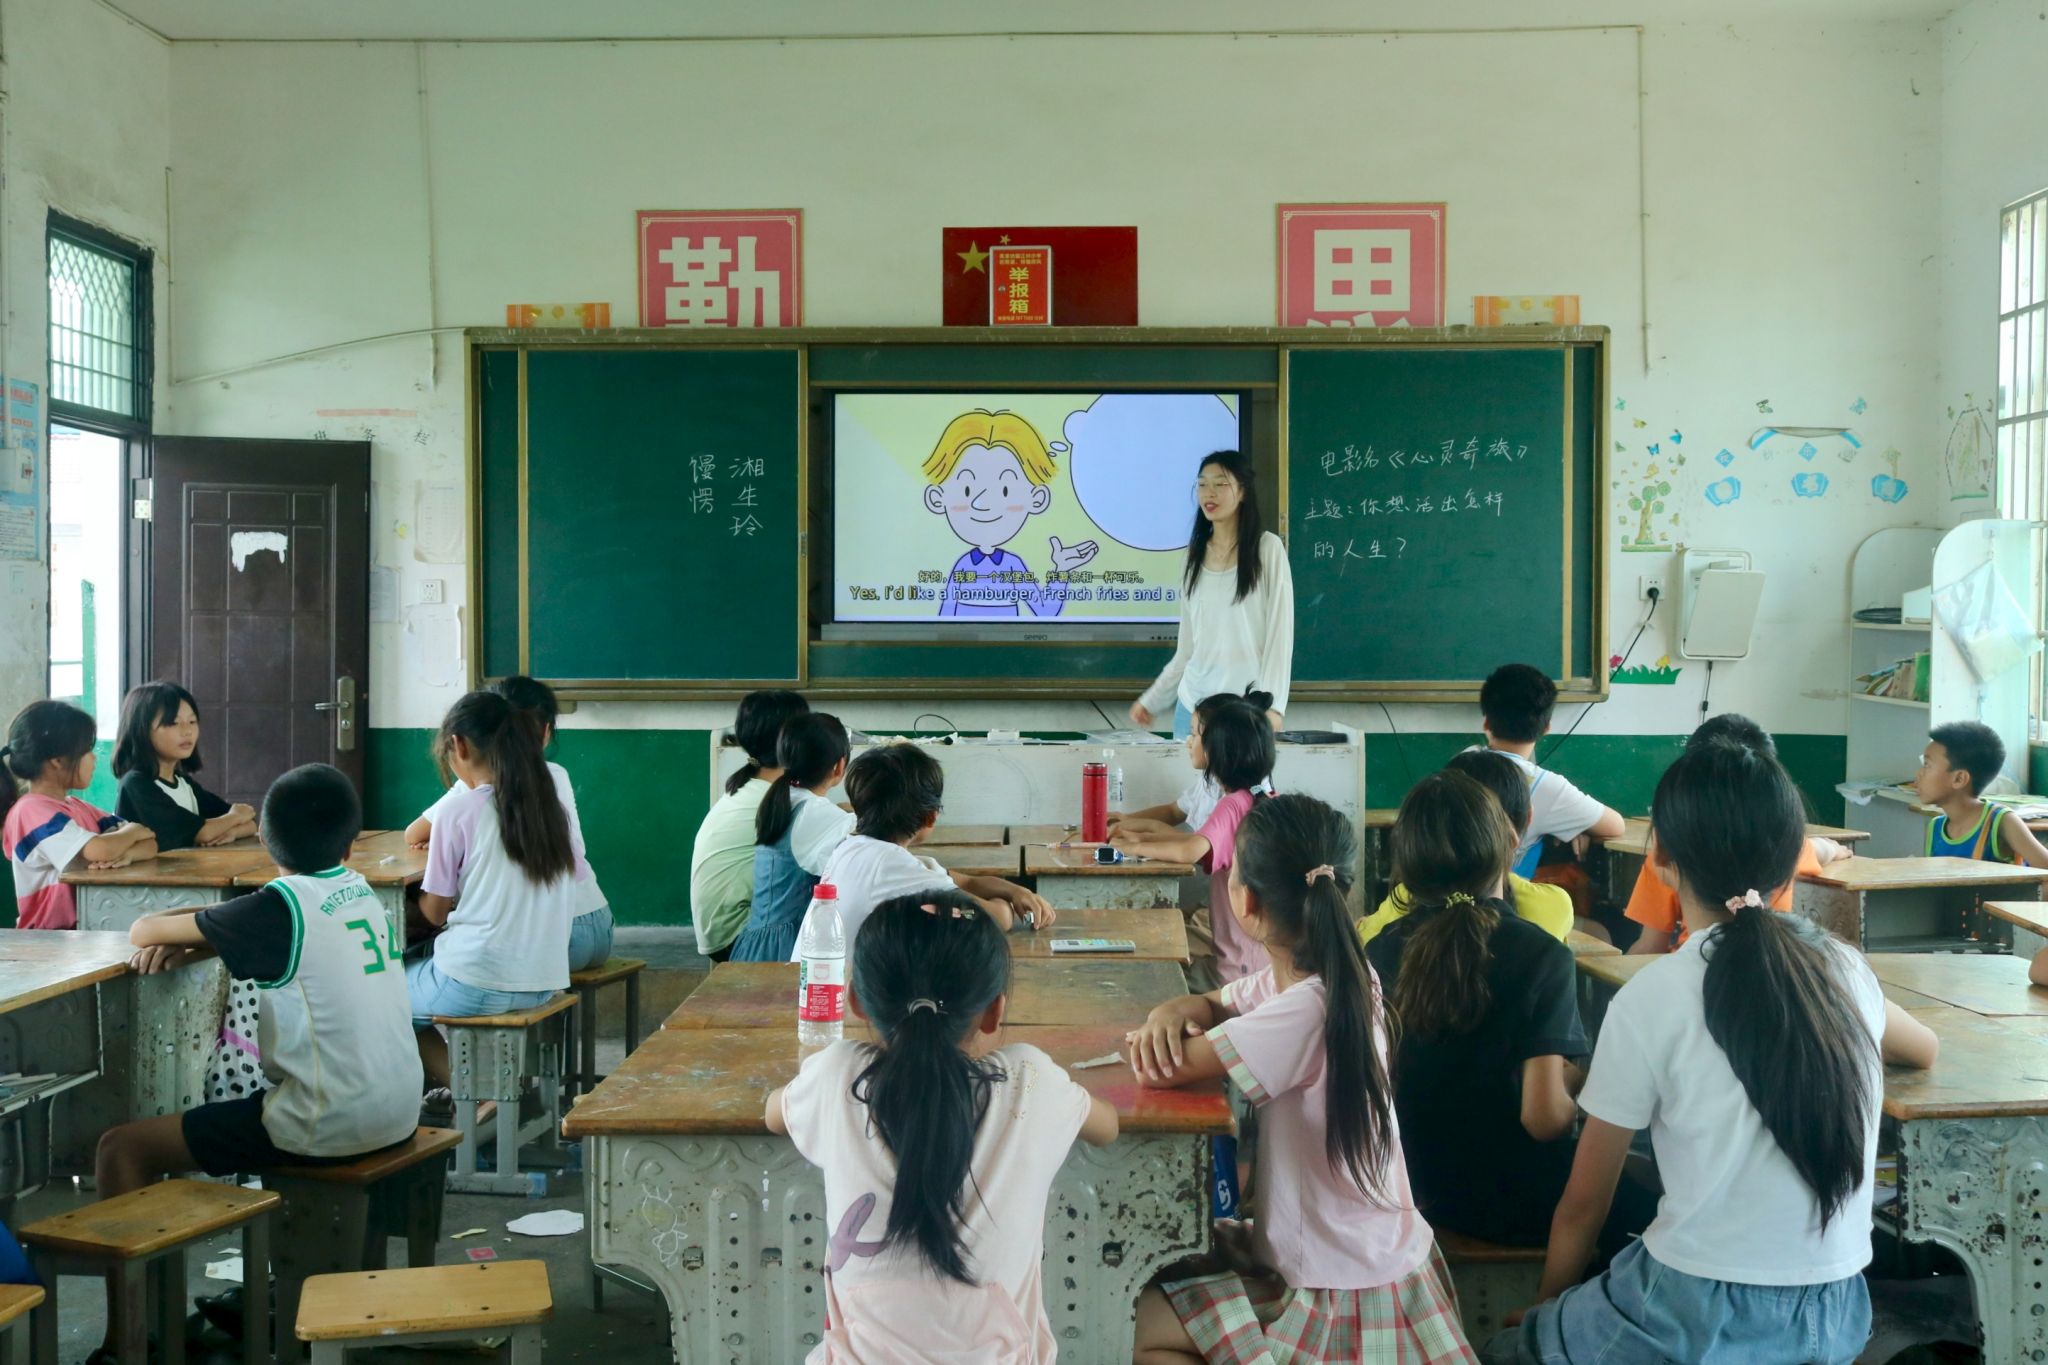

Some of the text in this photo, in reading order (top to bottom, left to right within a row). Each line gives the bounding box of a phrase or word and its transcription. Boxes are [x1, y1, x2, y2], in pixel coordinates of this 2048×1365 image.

[659, 236, 780, 327] 勤
[1009, 267, 1029, 314] 举报箱
[1321, 436, 1528, 477] 电影名《心灵奇旅》
[849, 586, 880, 600] Yes.
[884, 586, 904, 600] I'd
[908, 585, 935, 600] like
[939, 589, 948, 600] a
[952, 585, 1039, 602] hamburger,
[1043, 586, 1092, 600] French
[1096, 585, 1129, 600] fries
[1133, 587, 1162, 600] and
[1165, 590, 1175, 600] a
[346, 916, 403, 975] 34
